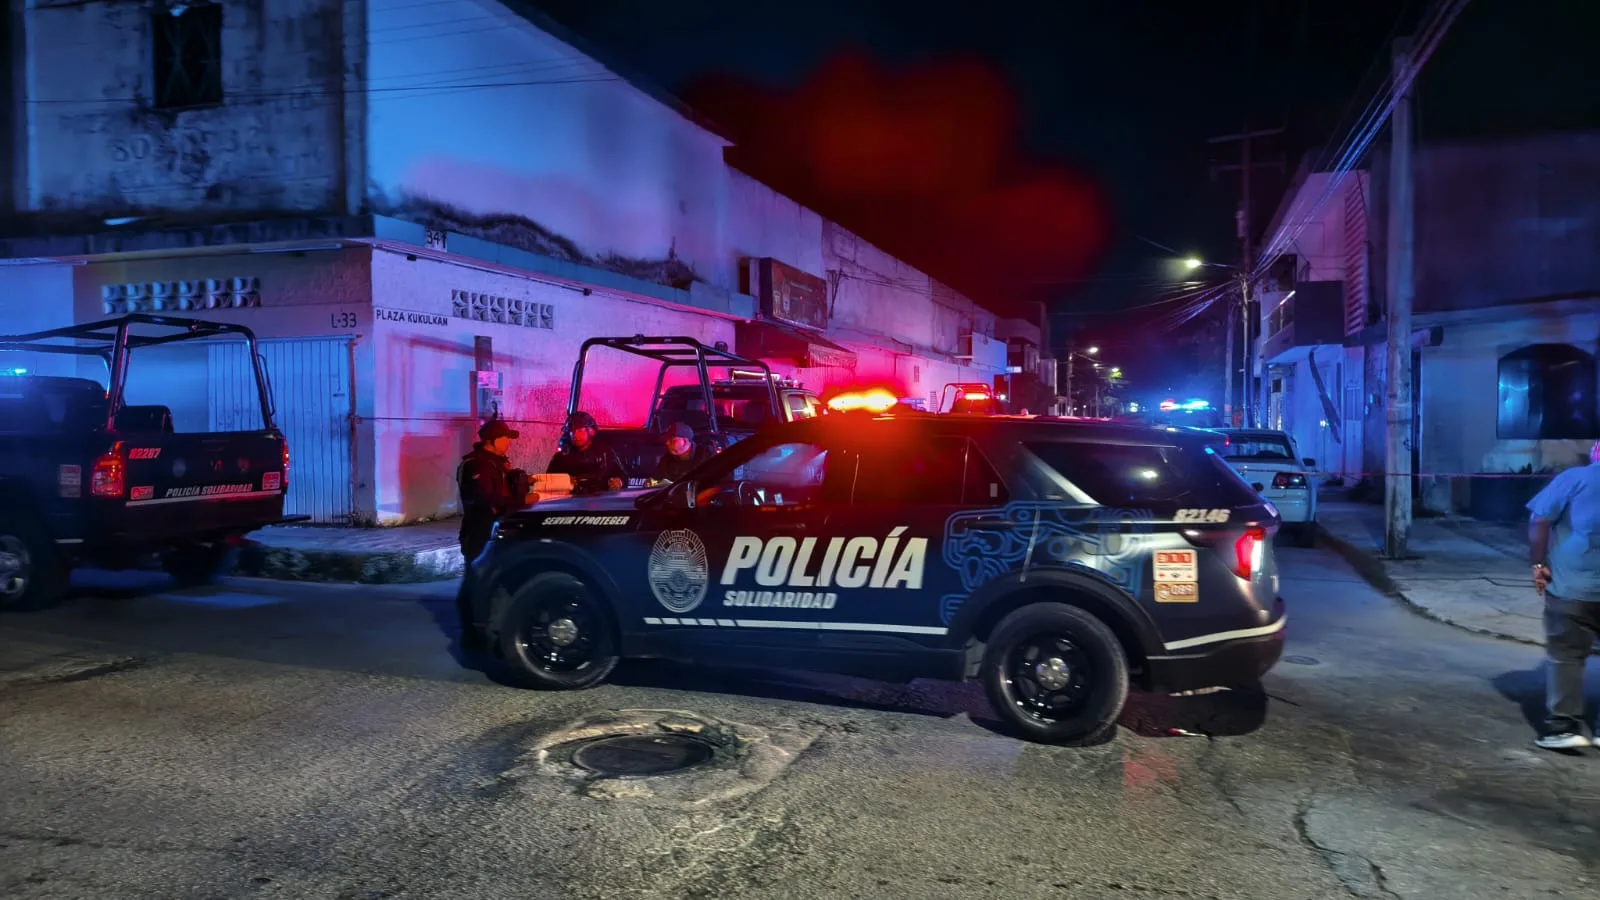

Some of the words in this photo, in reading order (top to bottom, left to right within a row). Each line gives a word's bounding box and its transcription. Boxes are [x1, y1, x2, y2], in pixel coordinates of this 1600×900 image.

[330, 312, 357, 329] L-33
[376, 309, 405, 322] PLAZA
[407, 312, 448, 326] KUKULKAN
[201, 482, 253, 495] SOLIDARIDAD
[541, 515, 577, 526] SERVIR
[579, 515, 631, 526] PROTEGER
[720, 526, 929, 589] POLICÍA
[723, 590, 838, 609] SOLIDARIDAD
